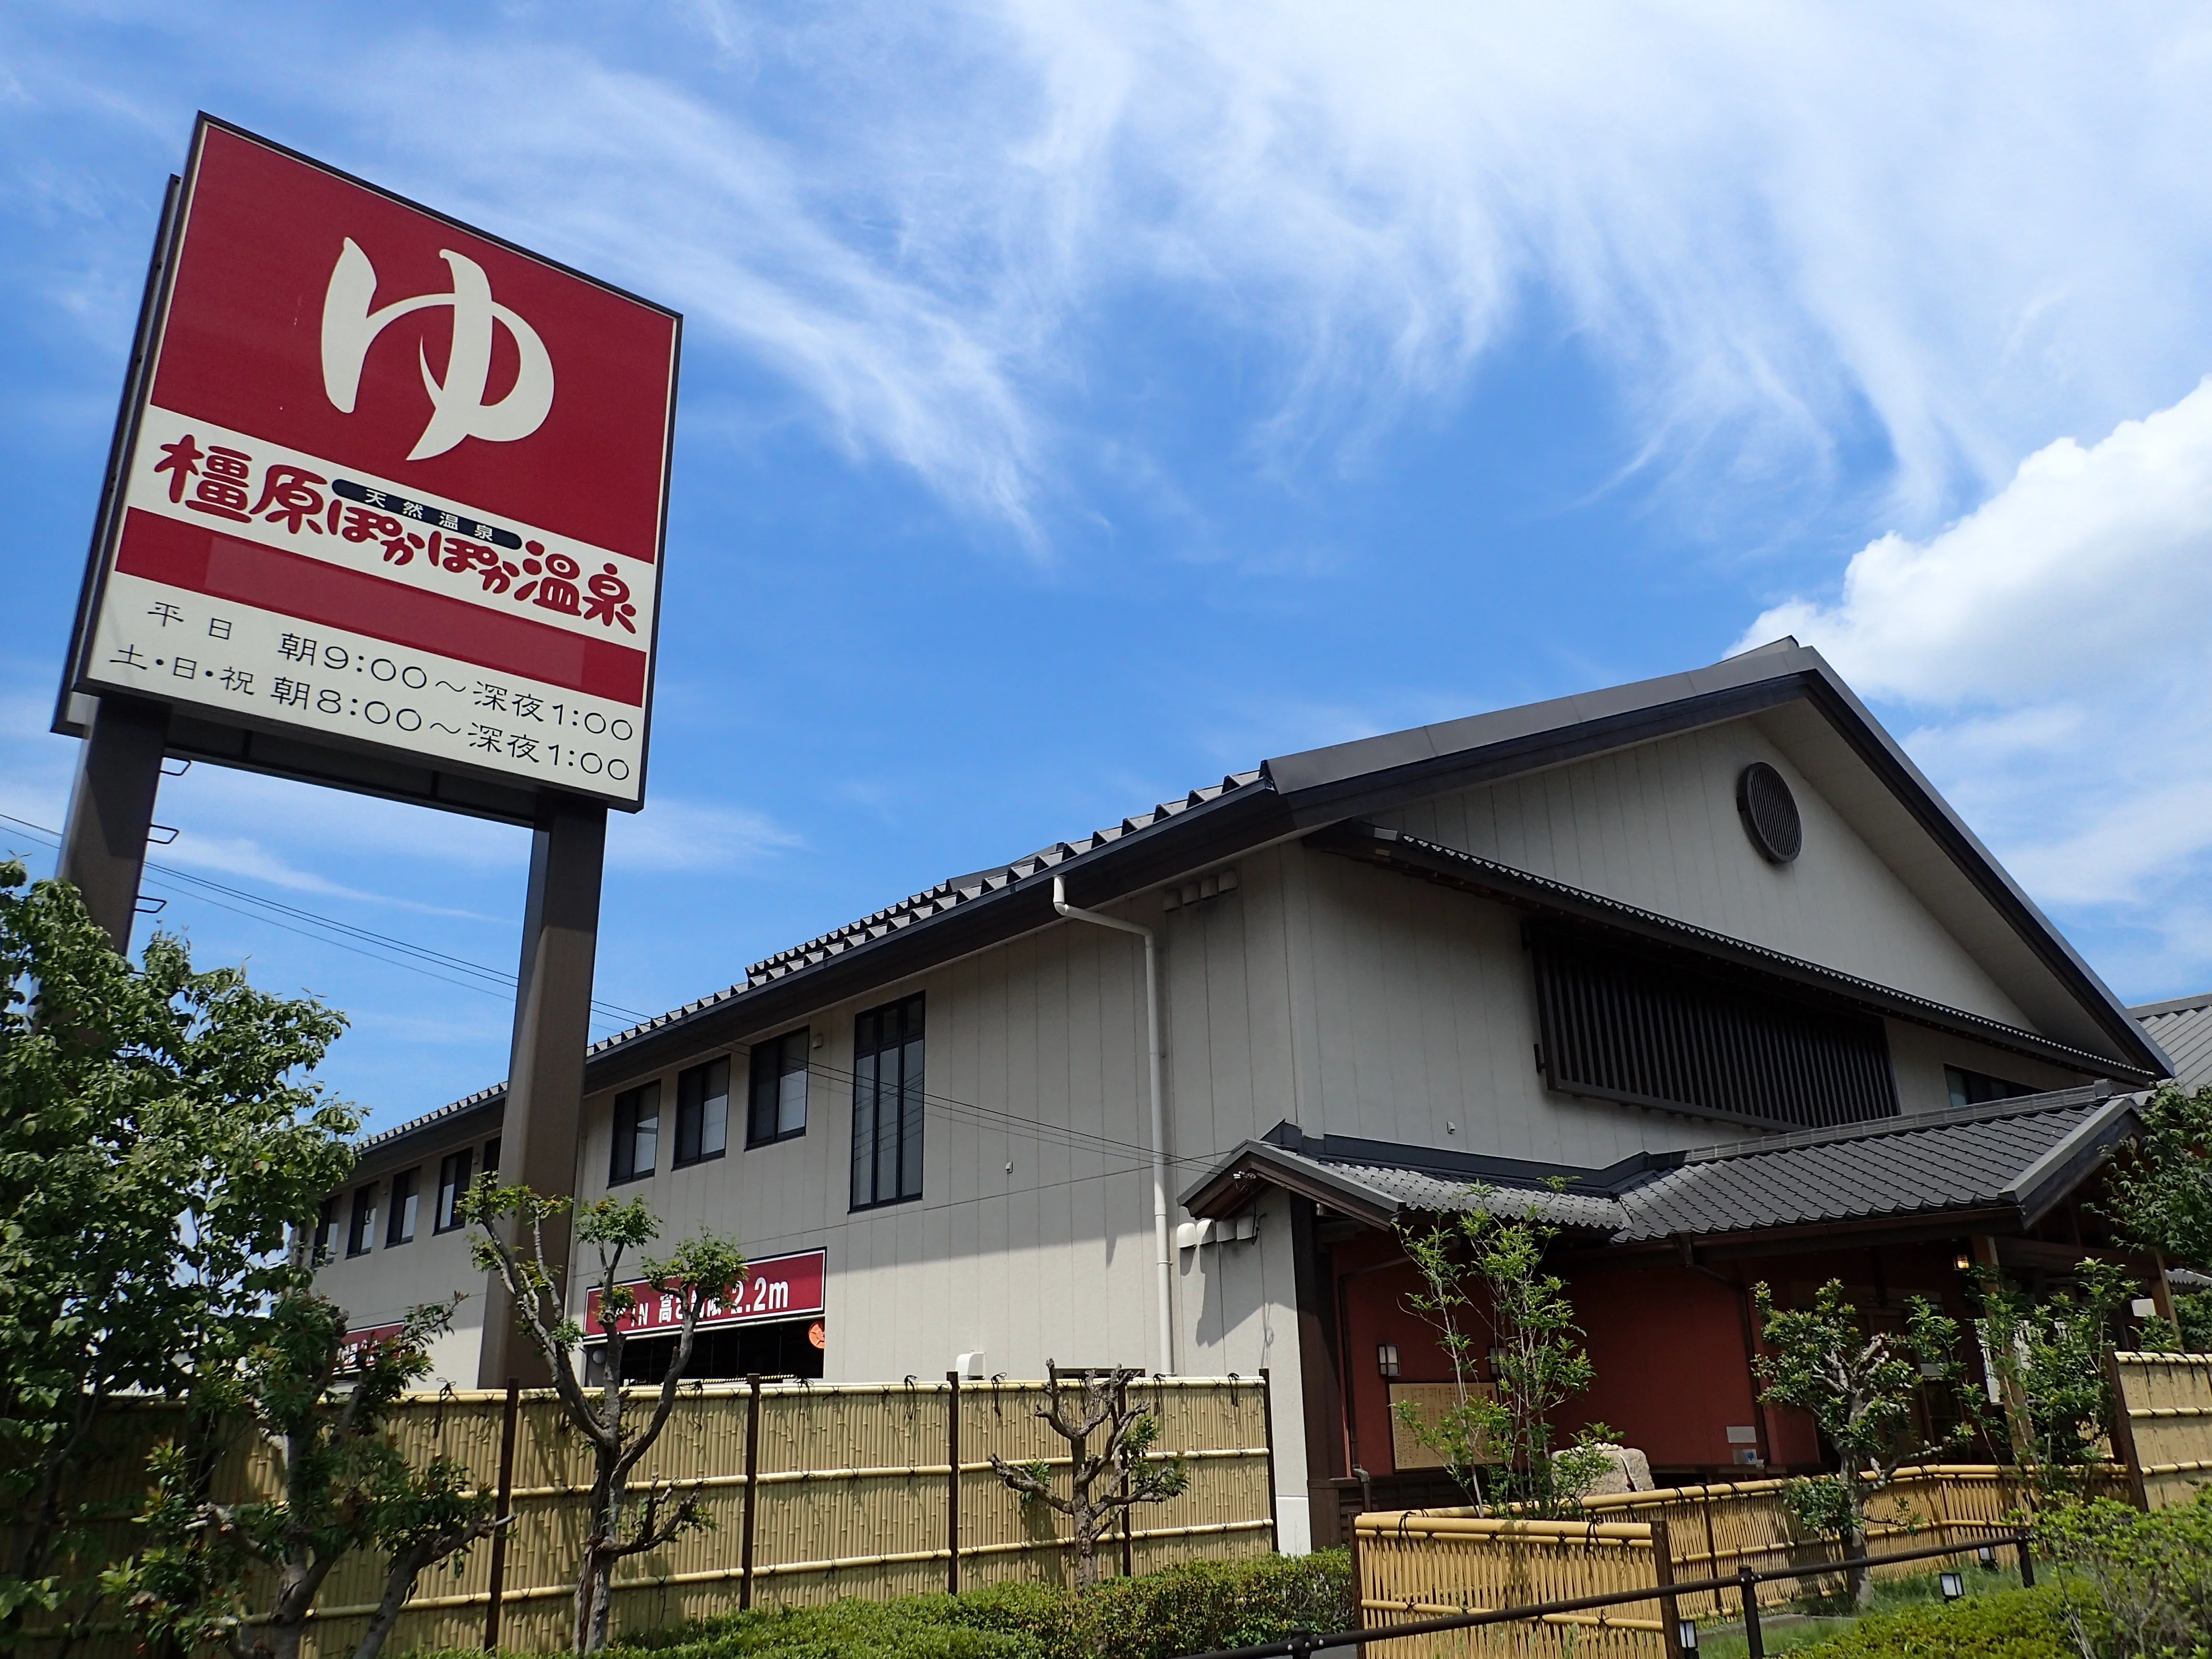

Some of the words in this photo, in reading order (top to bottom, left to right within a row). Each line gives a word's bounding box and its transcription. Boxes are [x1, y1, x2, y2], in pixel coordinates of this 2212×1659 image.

[321, 237, 554, 461] ゆ
[154, 434, 637, 634] 橿原ぽかぽか温泉
[364, 488, 493, 541] 天然温泉
[731, 1276, 789, 1314] 2.2m
